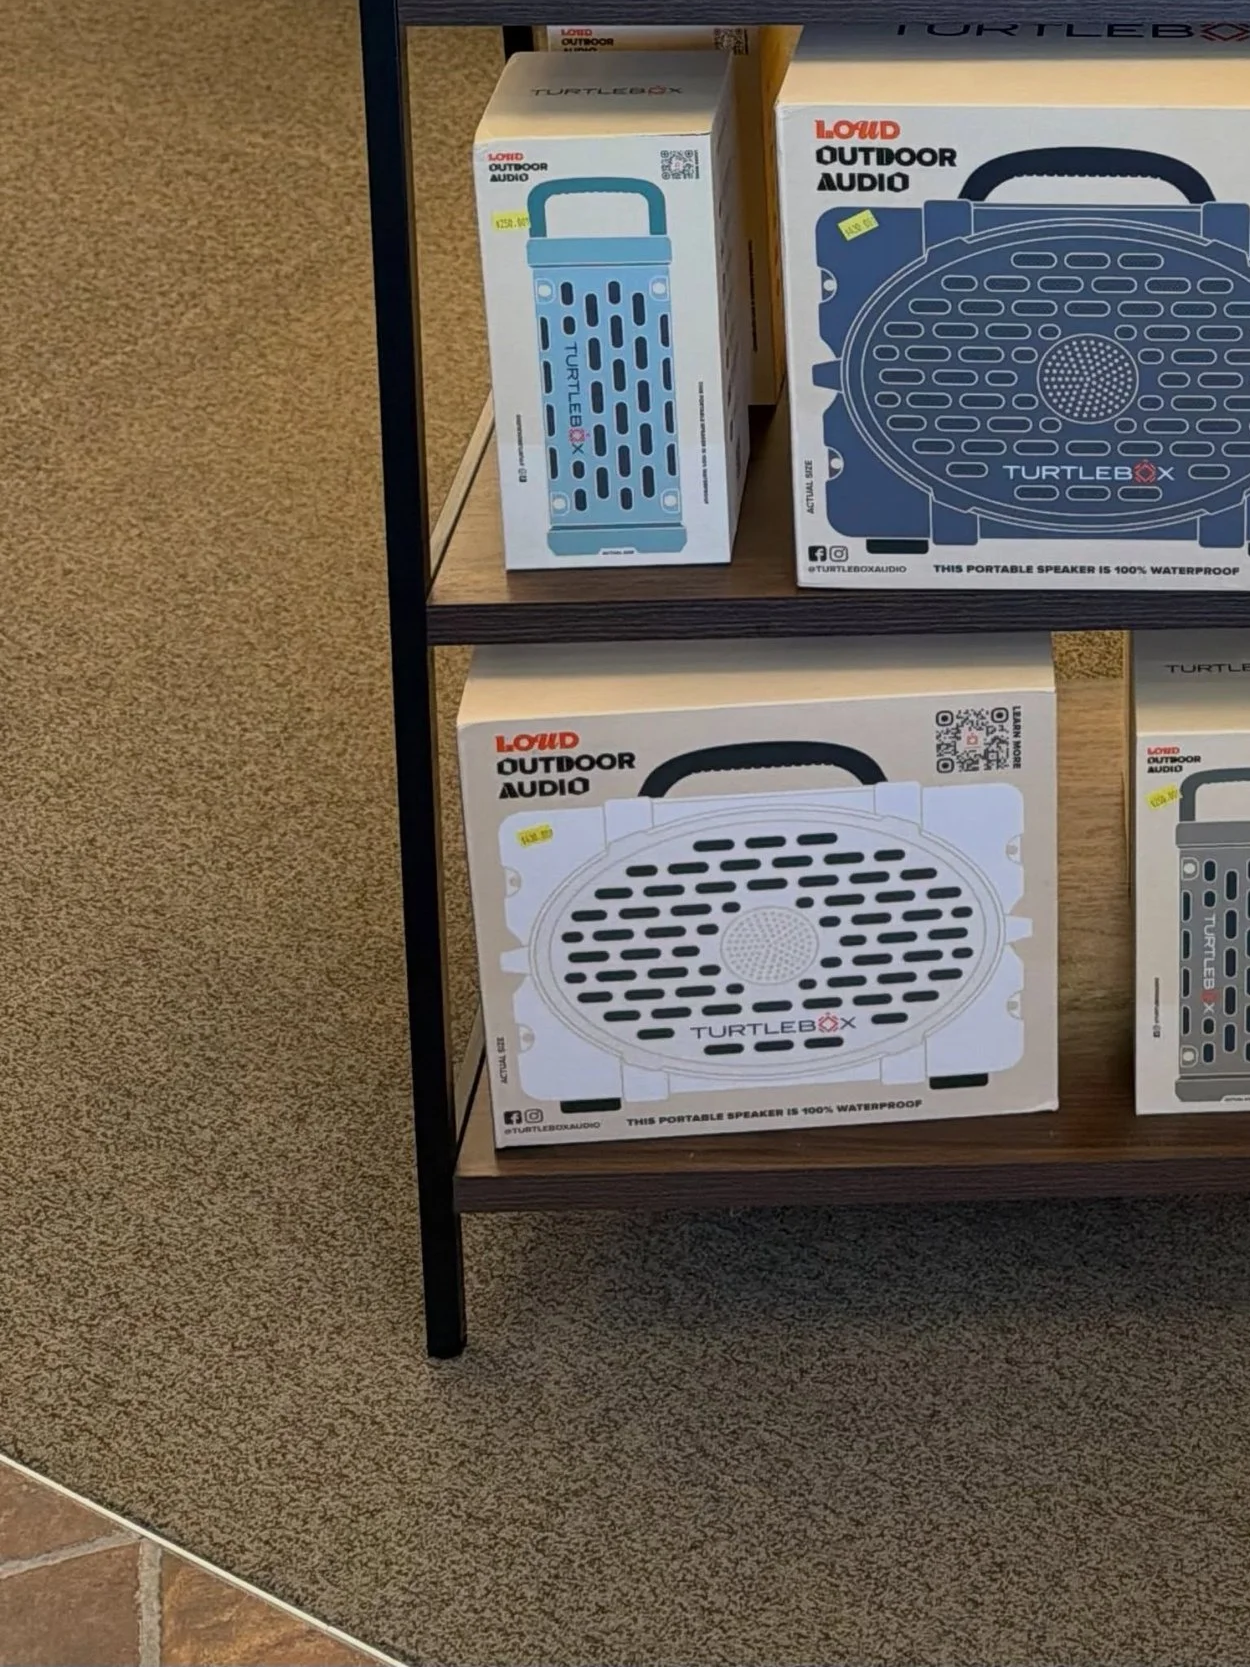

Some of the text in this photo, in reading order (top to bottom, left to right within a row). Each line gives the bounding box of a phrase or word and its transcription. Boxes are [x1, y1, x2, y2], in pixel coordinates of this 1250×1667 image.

[531, 85, 683, 97] TURTLEBOX
[815, 119, 901, 140] LOUD
[488, 152, 525, 162] LOUD
[488, 163, 548, 172] OUTDOOR
[815, 145, 958, 167] OUTDOOR
[489, 173, 529, 183] AUDIO
[817, 171, 910, 193] AUDIO
[564, 341, 590, 455] TURTLEBOX
[1002, 459, 1176, 484] TURTLEBOX
[805, 460, 815, 515] ACTUAL SIZE
[808, 565, 907, 574] @TURTLEBOXAUDIO
[933, 564, 1241, 576] THIS PORTABLE SPEAKER IS 100% WATERPROOF
[495, 731, 580, 754] LOUD
[1011, 705, 1022, 770] LEARN MORE
[497, 752, 636, 776] OUTDOOR
[499, 777, 590, 800] AUDIO
[1202, 913, 1221, 1014] TURTLEBOX
[689, 1011, 857, 1041] TURTLEBOX
[497, 1036, 508, 1085] ACTUAL SIZE
[626, 1099, 923, 1127] THIS PORTABLE SPEAKER IS 100% WATERPROOF
[503, 1121, 601, 1135] @TURTLEBOXAUDIO
